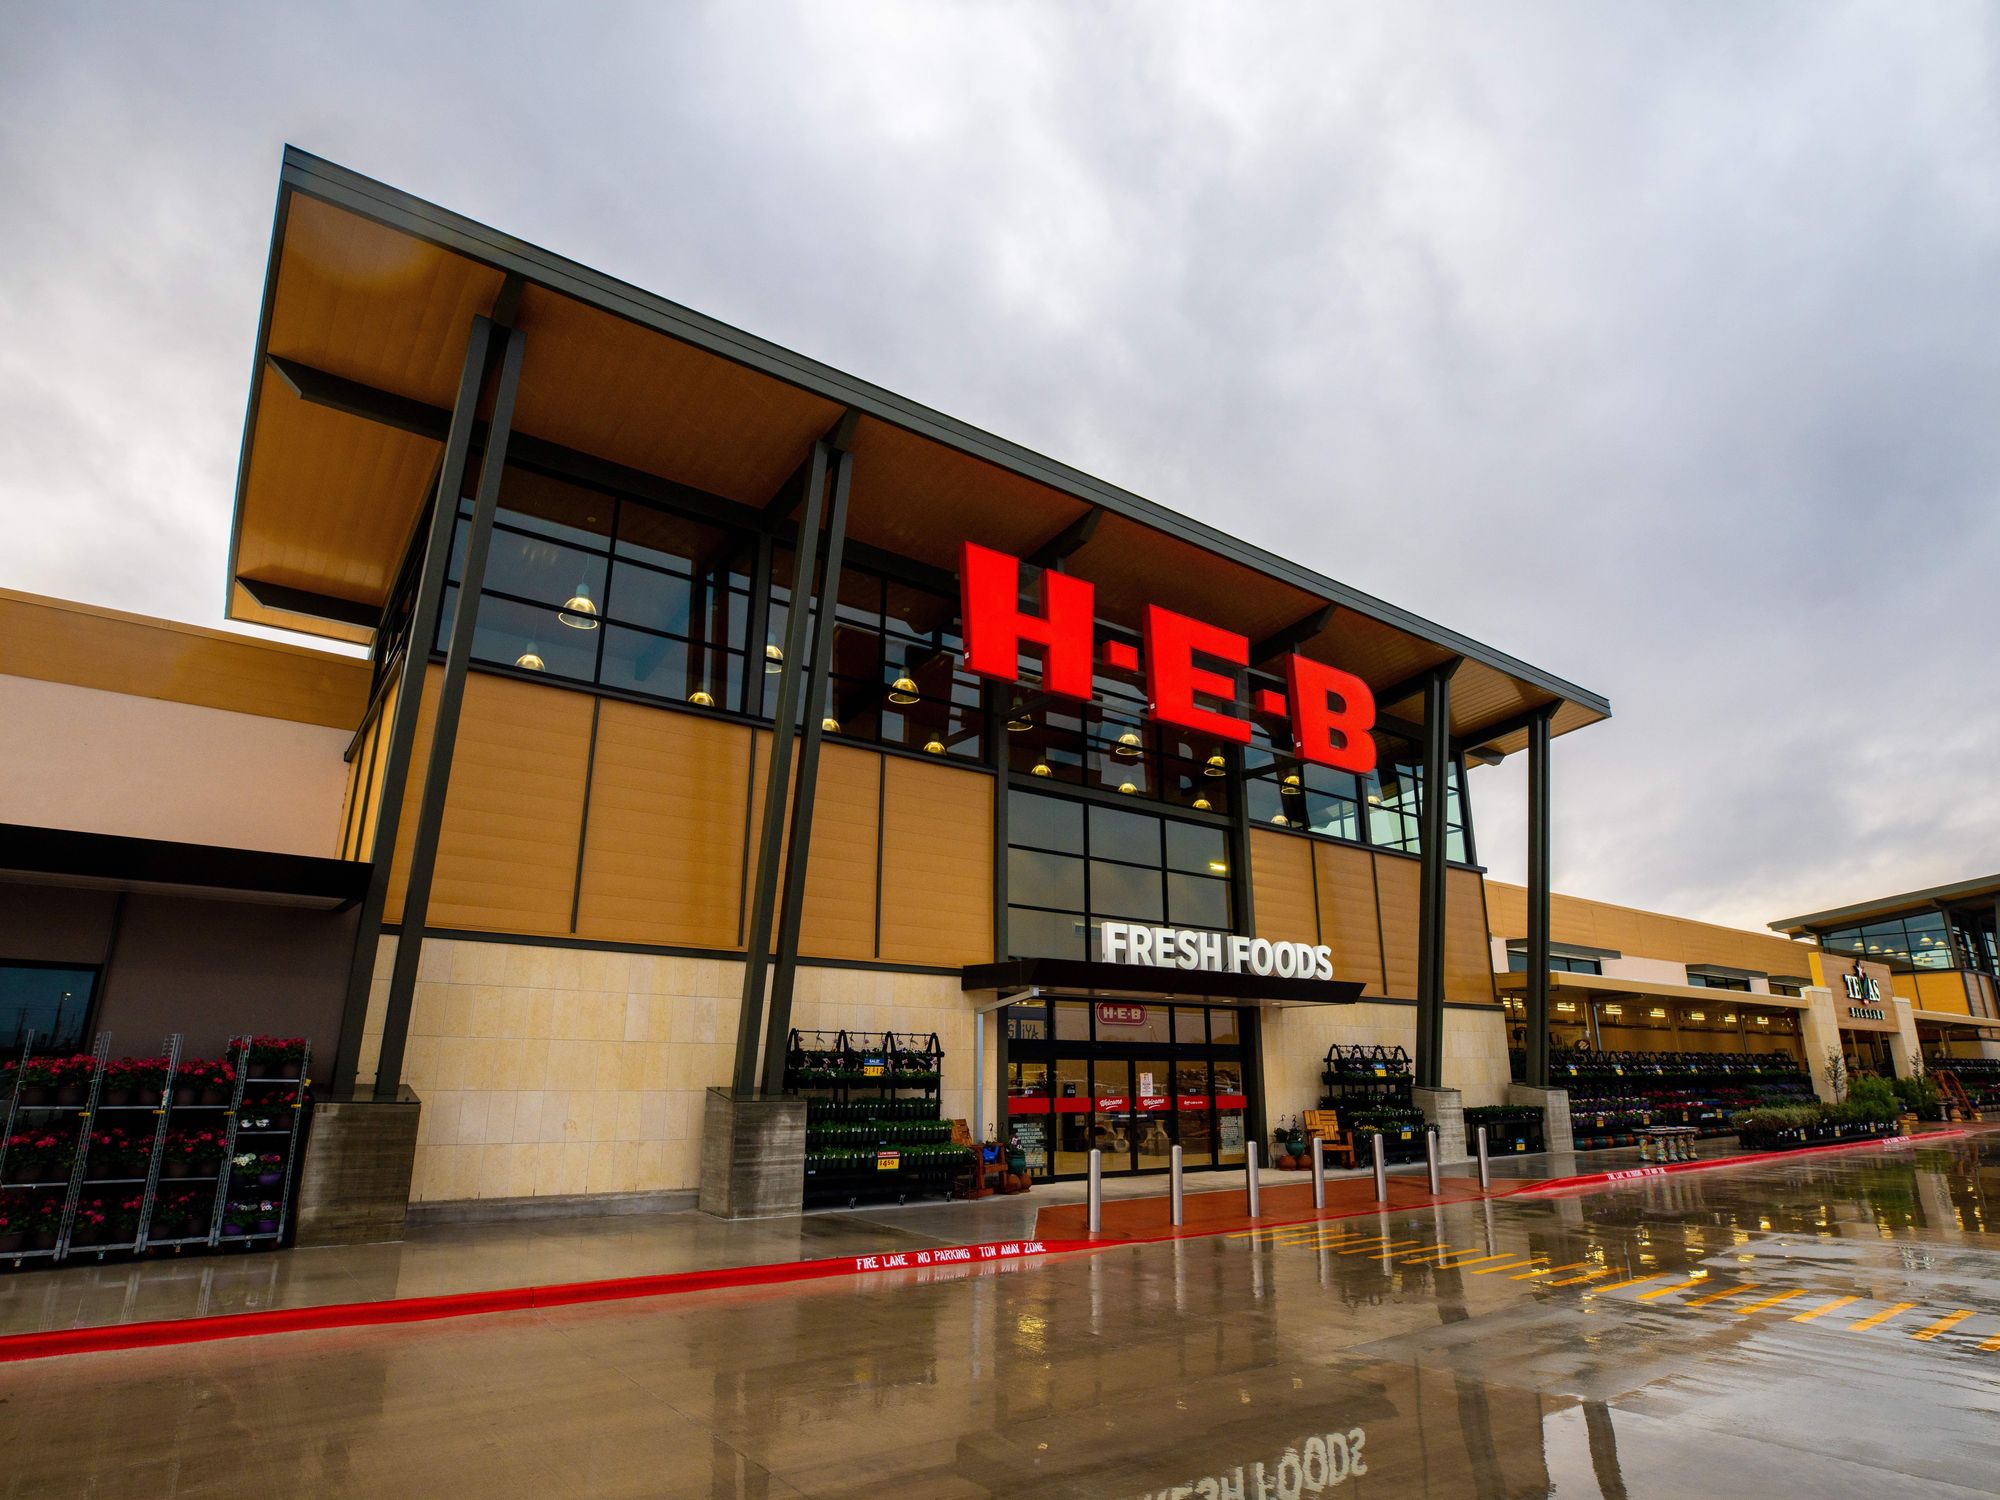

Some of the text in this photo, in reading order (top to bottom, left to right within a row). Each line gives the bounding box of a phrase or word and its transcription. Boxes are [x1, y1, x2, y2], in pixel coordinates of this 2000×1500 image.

[960, 541, 1377, 775] H-E-B
[1101, 921, 1334, 981] FRESH FOODS
[856, 1241, 1047, 1270] FIRE LANE NO PARKING TOW AWAY ZONE
